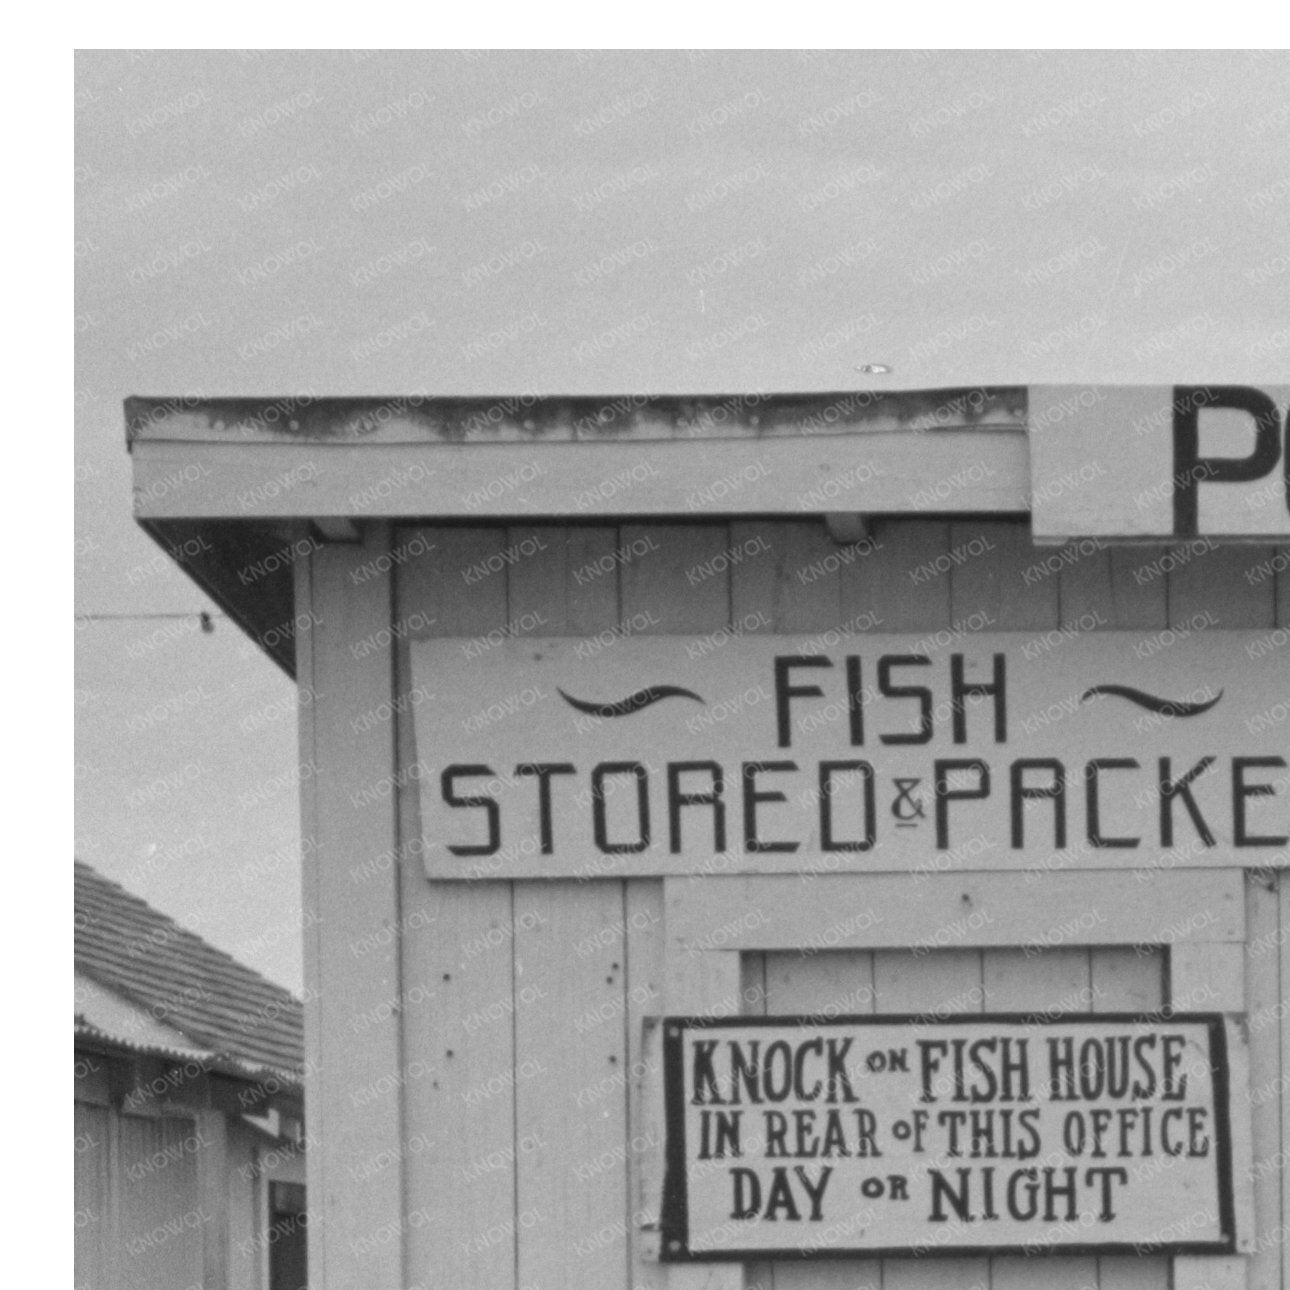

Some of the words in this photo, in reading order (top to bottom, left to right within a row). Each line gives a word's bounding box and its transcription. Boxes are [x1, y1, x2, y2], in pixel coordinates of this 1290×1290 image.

[774, 653, 1006, 747] FISH
[441, 760, 876, 856] STORED
[691, 1037, 859, 1105] KNOCK
[916, 1037, 1029, 1103] FISH
[1045, 1034, 1188, 1102] HOUSE
[698, 1109, 744, 1160] IN
[763, 1109, 882, 1158] REAR
[938, 1107, 1042, 1160] THIS
[1063, 1107, 1209, 1157] OFFICE
[729, 1166, 834, 1221] DAY
[926, 1166, 1128, 1223] NIGHT
